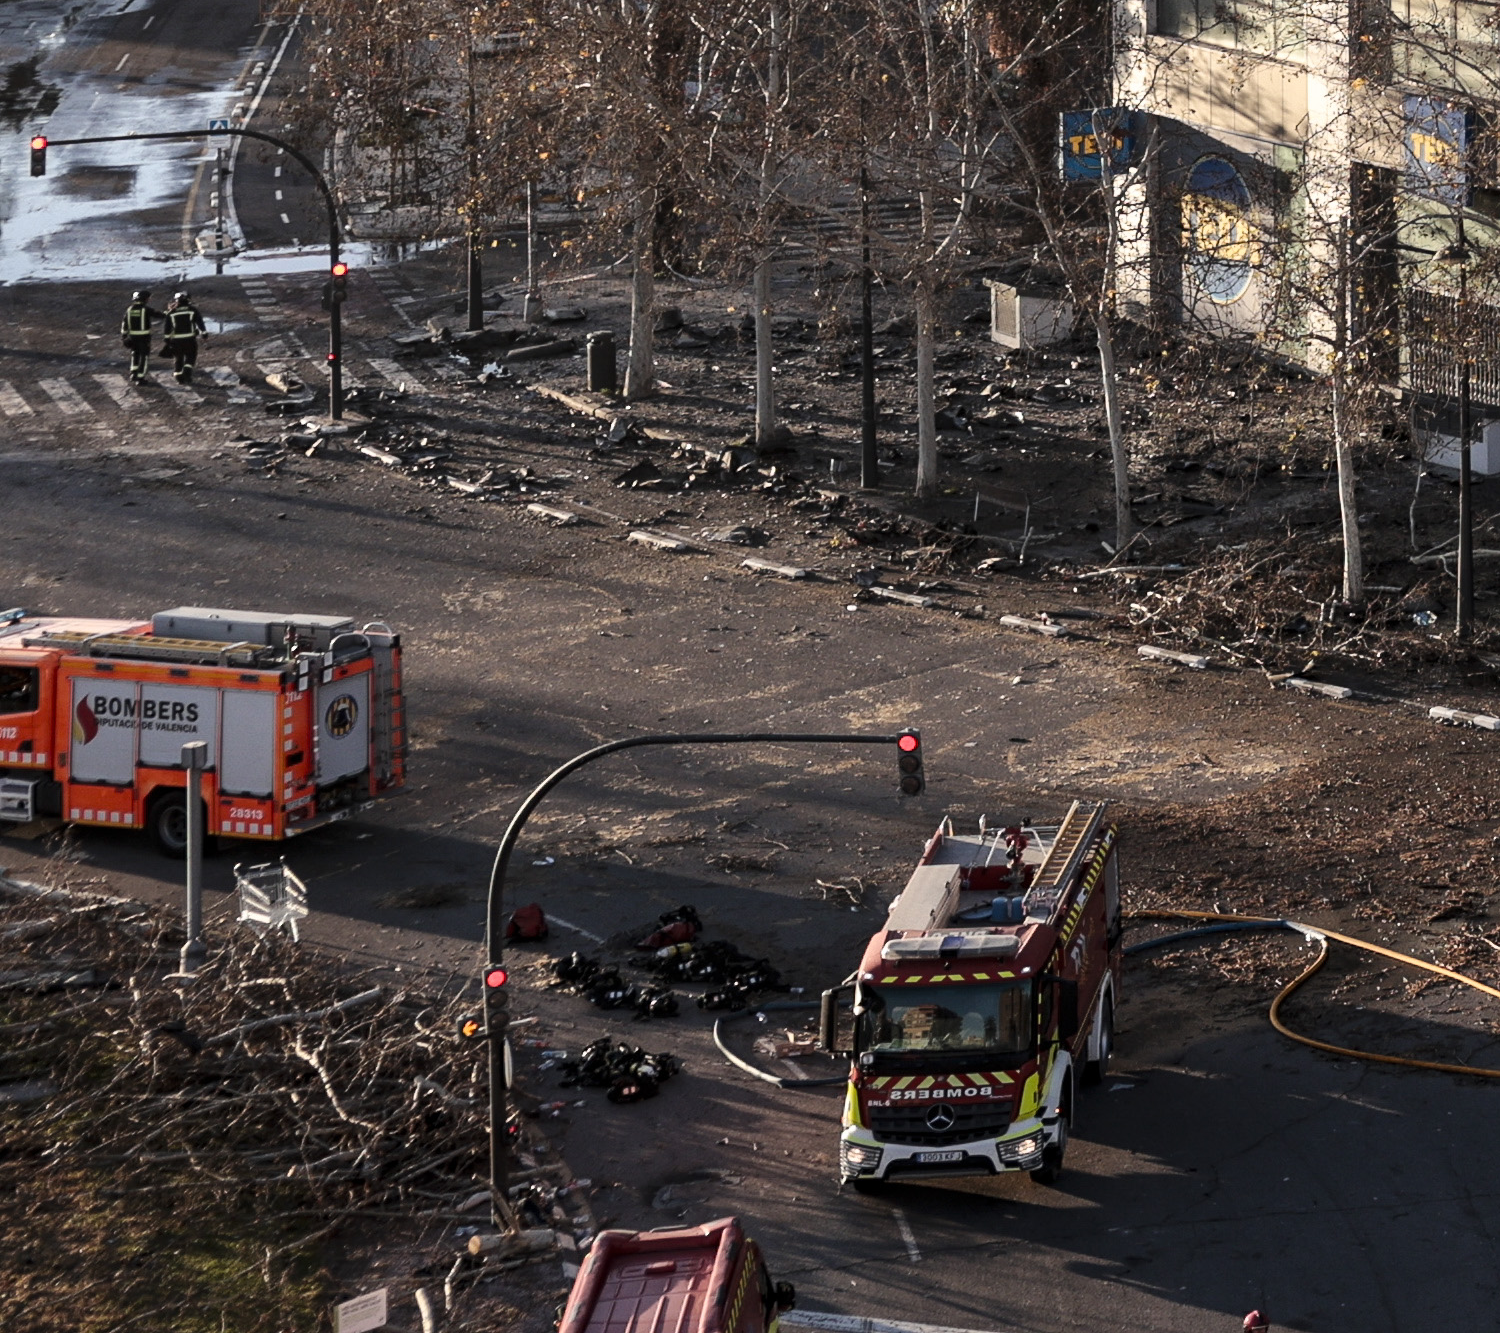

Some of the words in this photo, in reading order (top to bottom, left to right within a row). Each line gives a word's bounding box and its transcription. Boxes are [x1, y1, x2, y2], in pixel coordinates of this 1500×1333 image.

[94, 696, 199, 723] BOMBERS
[142, 721, 153, 730] DE
[155, 723, 199, 733] VALENCIA
[229, 807, 264, 821] 28313
